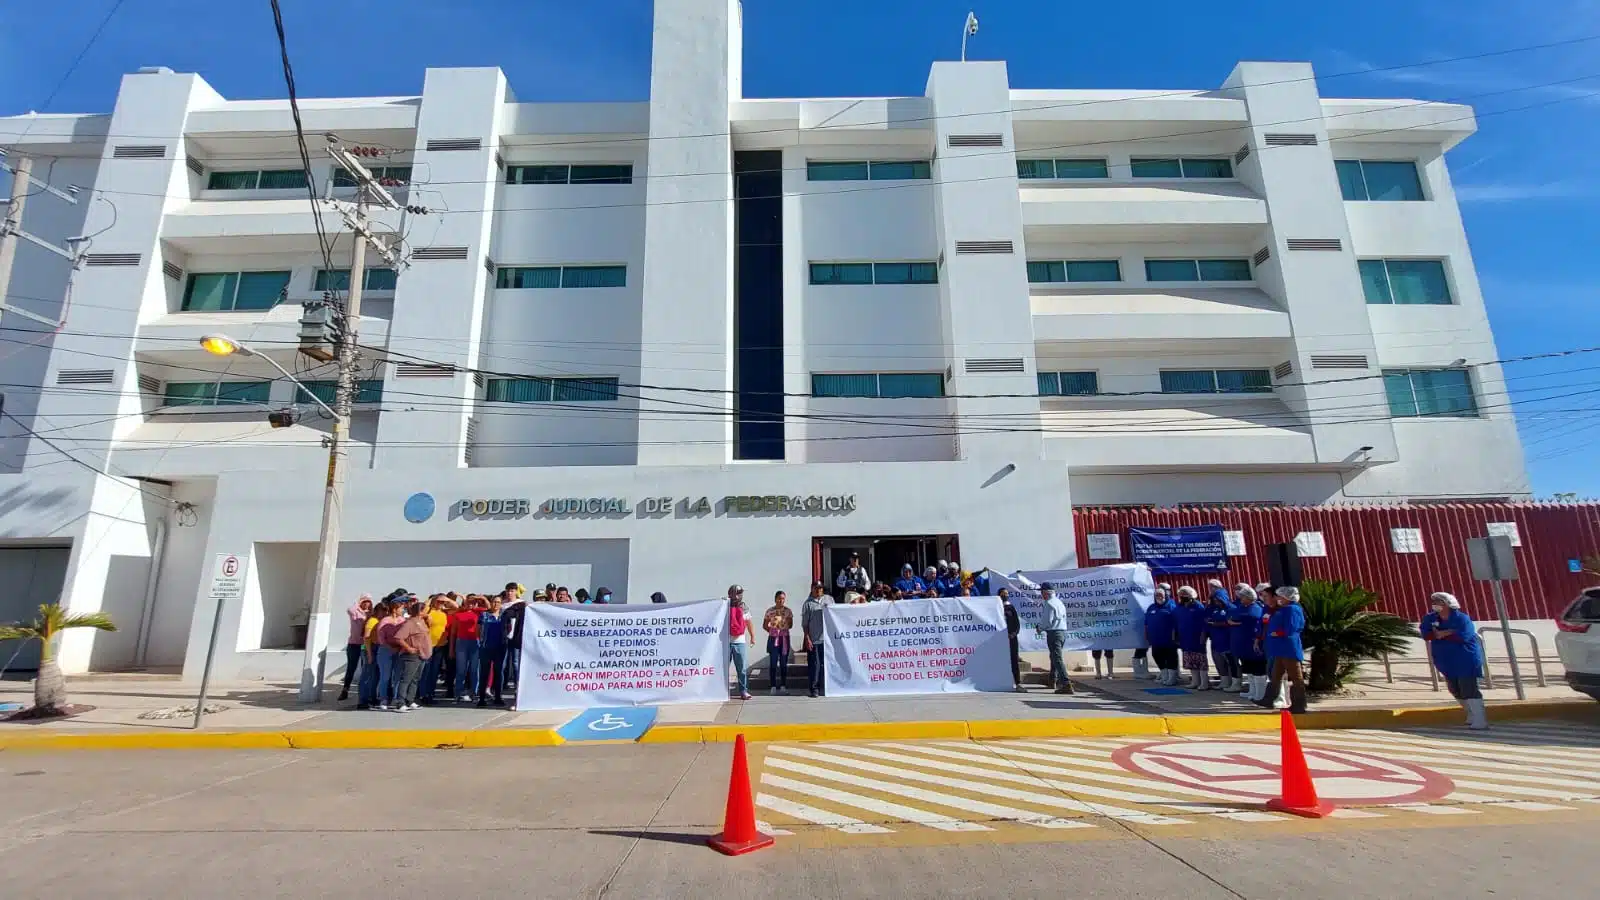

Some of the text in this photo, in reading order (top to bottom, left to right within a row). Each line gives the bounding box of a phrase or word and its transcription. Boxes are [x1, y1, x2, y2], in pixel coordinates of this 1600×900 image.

[459, 495, 857, 515] PODER JUDICIAL DE LA FEDERACION
[1077, 580, 1089, 588] DE
[1090, 577, 1126, 587] DISTRITO
[1088, 600, 1098, 608] SU
[1100, 598, 1128, 607] APOYO
[1085, 609, 1130, 618] NUESTROS
[564, 616, 694, 627] JUEZ SÉPTIMO DE DISTRITO
[856, 613, 973, 627] JUEZ SÉPTIMO DE DISTRITO
[1083, 619, 1129, 628] SUSTENTO
[538, 625, 718, 638] LAS DESBABEZADORAS DE CAMARÓN
[834, 623, 997, 640] LAS DESBABEZADORAS DE CAMARÓN
[598, 638, 660, 648] LE PEDIMOS:
[888, 637, 943, 648] LE DECIMOS:
[599, 649, 658, 658] ¡APOYENOS!
[858, 647, 975, 662] ¡EL CAMARÓN IMPORTADO!
[553, 657, 701, 671] ¡NO AL CAMARÓN IMPORTADO!
[868, 658, 966, 671] NOS QUITA EL EMPLEO
[595, 669, 653, 679] IMPORTADO
[663, 668, 670, 677] A
[672, 667, 700, 677] FALTA
[702, 667, 715, 676] DE
[871, 669, 965, 682] ¡EN TODO EL ESTADO!
[565, 682, 605, 691] COMIDA
[607, 680, 634, 690] PARA
[636, 680, 653, 689] MIS
